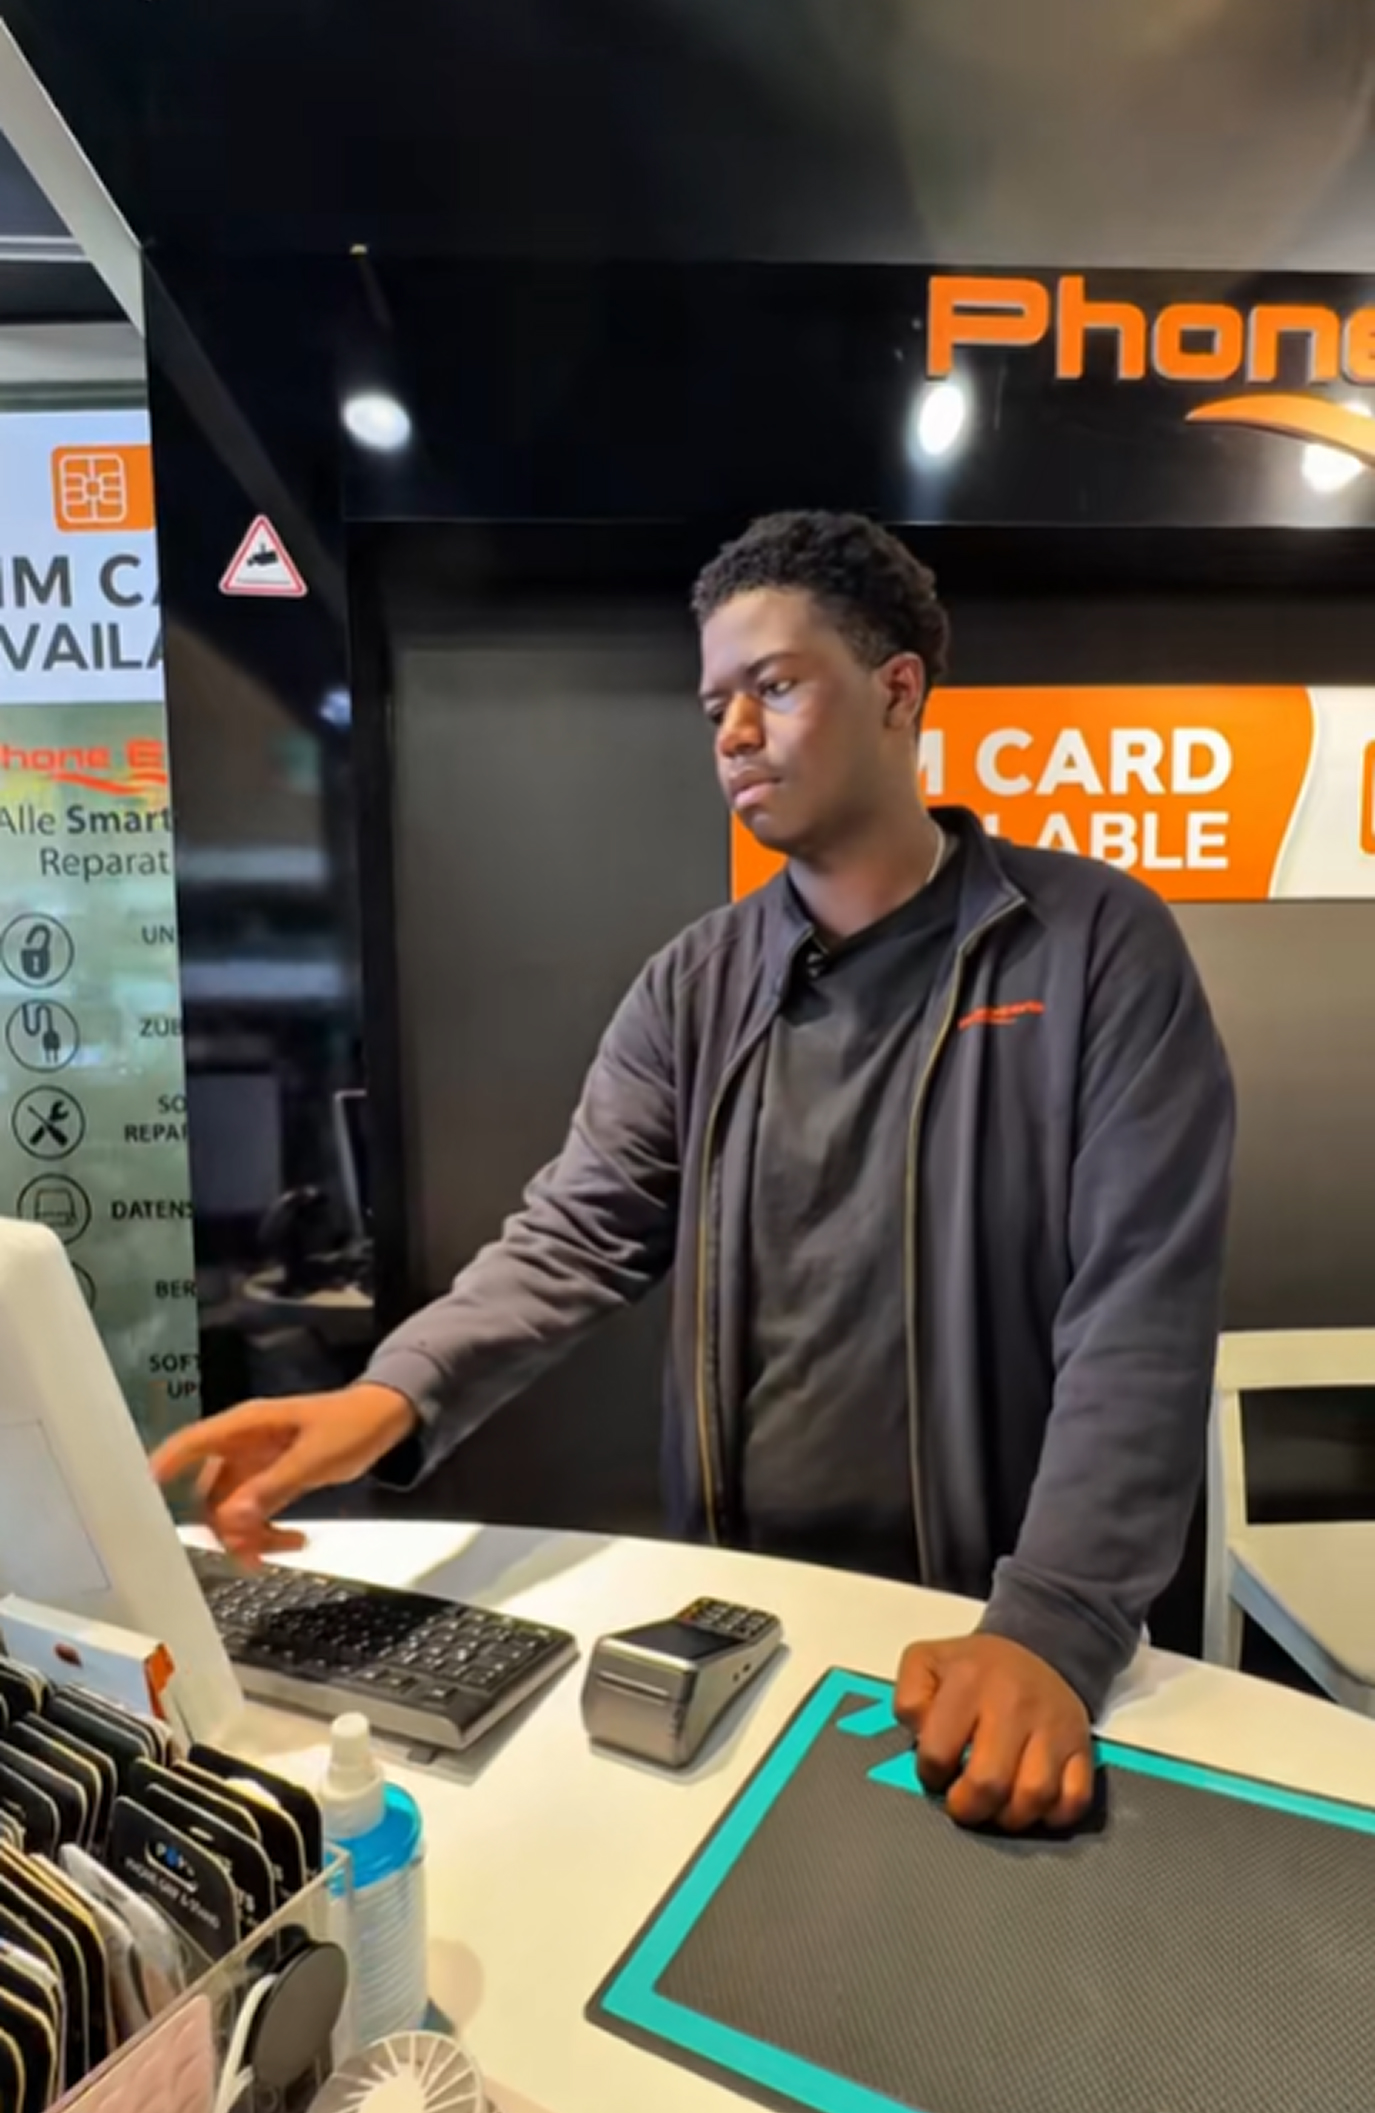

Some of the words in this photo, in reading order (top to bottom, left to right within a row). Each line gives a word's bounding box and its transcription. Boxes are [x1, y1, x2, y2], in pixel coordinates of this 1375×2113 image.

[99, 553, 160, 607] C
[0, 744, 110, 770] hone
[976, 727, 1232, 796] CARD
[40, 848, 170, 882] Reparat
